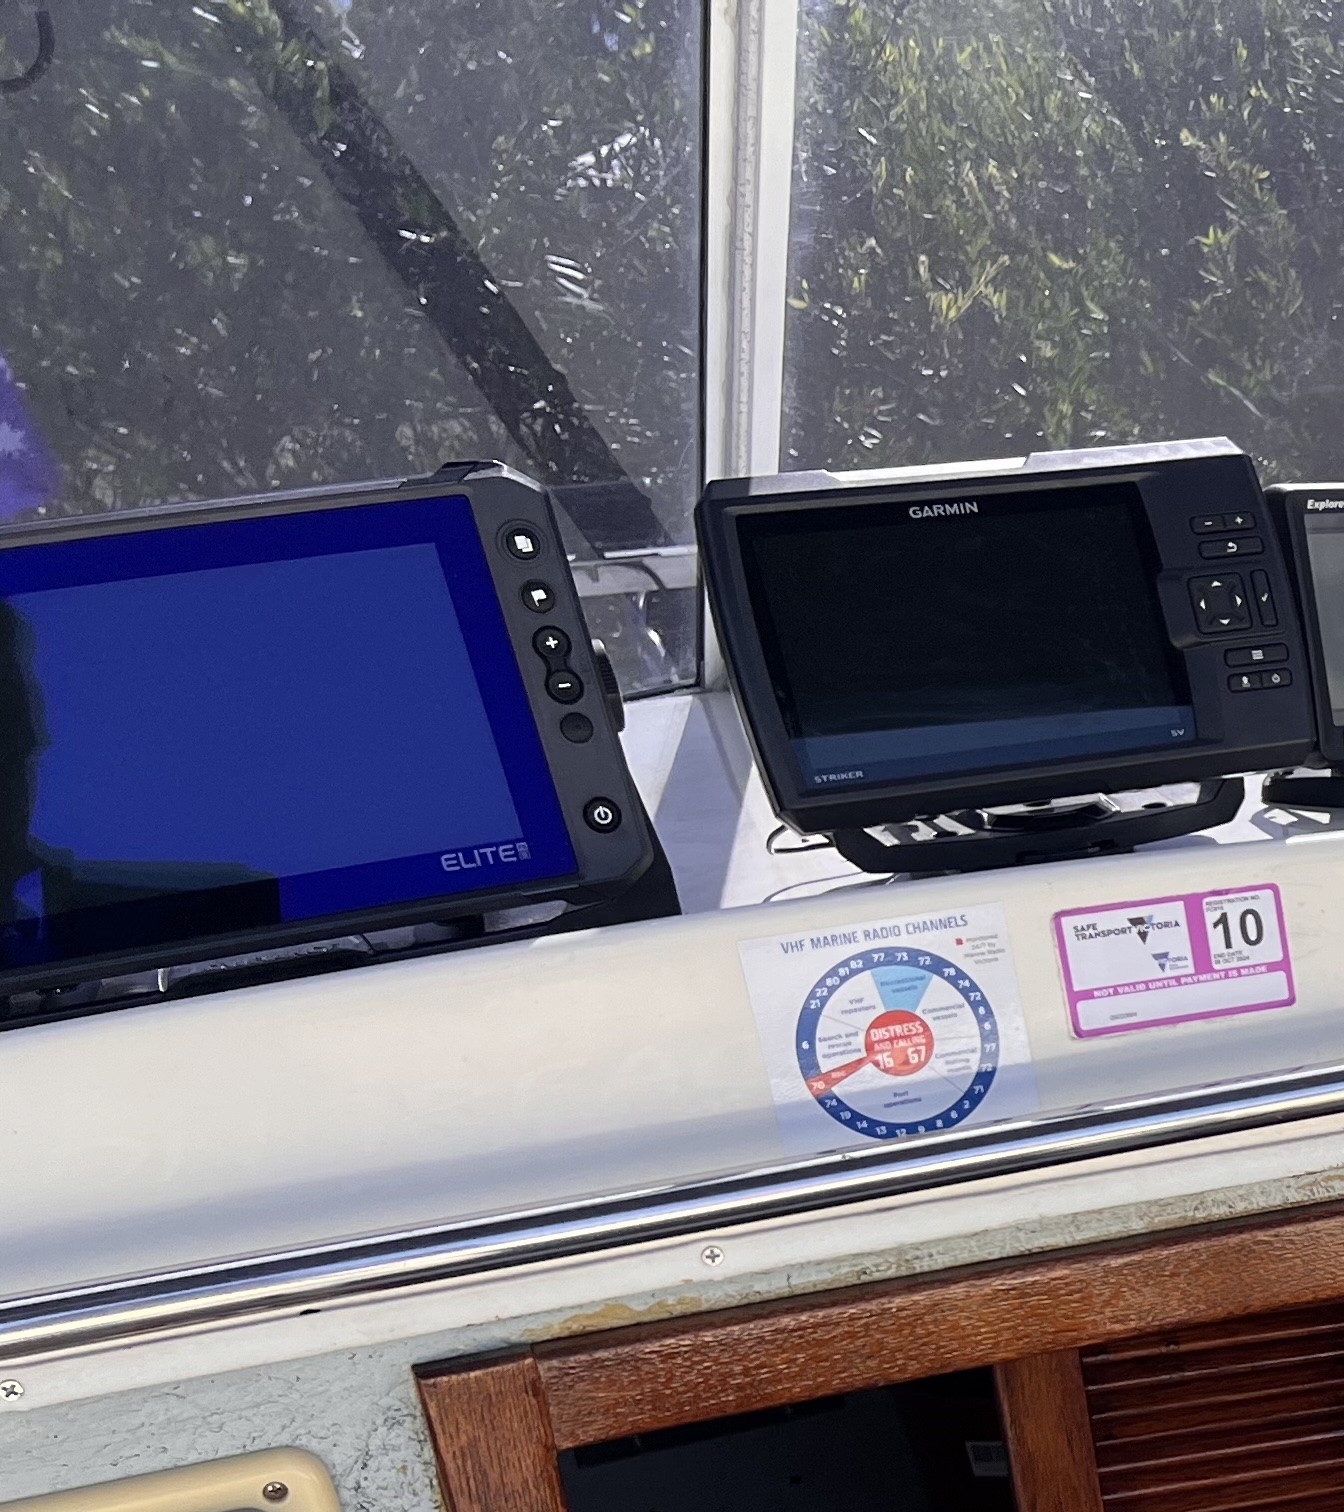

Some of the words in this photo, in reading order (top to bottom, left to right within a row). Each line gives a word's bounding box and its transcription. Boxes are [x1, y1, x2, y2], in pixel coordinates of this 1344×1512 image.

[909, 501, 979, 519] GARMIN
[814, 770, 864, 783] STRIKER
[440, 844, 517, 872] ELITE
[1073, 923, 1098, 933] SAFE
[1213, 908, 1264, 949] 10
[780, 939, 806, 954] VHF
[810, 931, 860, 950] MARINE
[863, 925, 902, 941] RADIO
[905, 914, 968, 935] CHANNELS
[1075, 926, 1132, 941] TRANSPORT
[872, 953, 885, 963] 77
[895, 952, 908, 961] 73
[918, 956, 931, 966] 72
[850, 960, 863, 969] 82
[825, 976, 840, 987] 80
[1093, 987, 1115, 998] NOT
[1117, 983, 1146, 994] VALID
[1148, 978, 1179, 990] UNTIL
[1180, 971, 1226, 985] PAYMENT
[1228, 969, 1238, 978] IS
[1240, 965, 1268, 976] MADE
[968, 992, 981, 1001] 72
[870, 1021, 924, 1041] DISTRESS
[984, 1022, 991, 1031] 6
[802, 1041, 810, 1050] 6
[874, 1041, 892, 1051] AND
[984, 1043, 996, 1053] 77
[907, 1046, 926, 1064] 67
[811, 1081, 825, 1090] 70
[875, 1126, 887, 1135] 13
